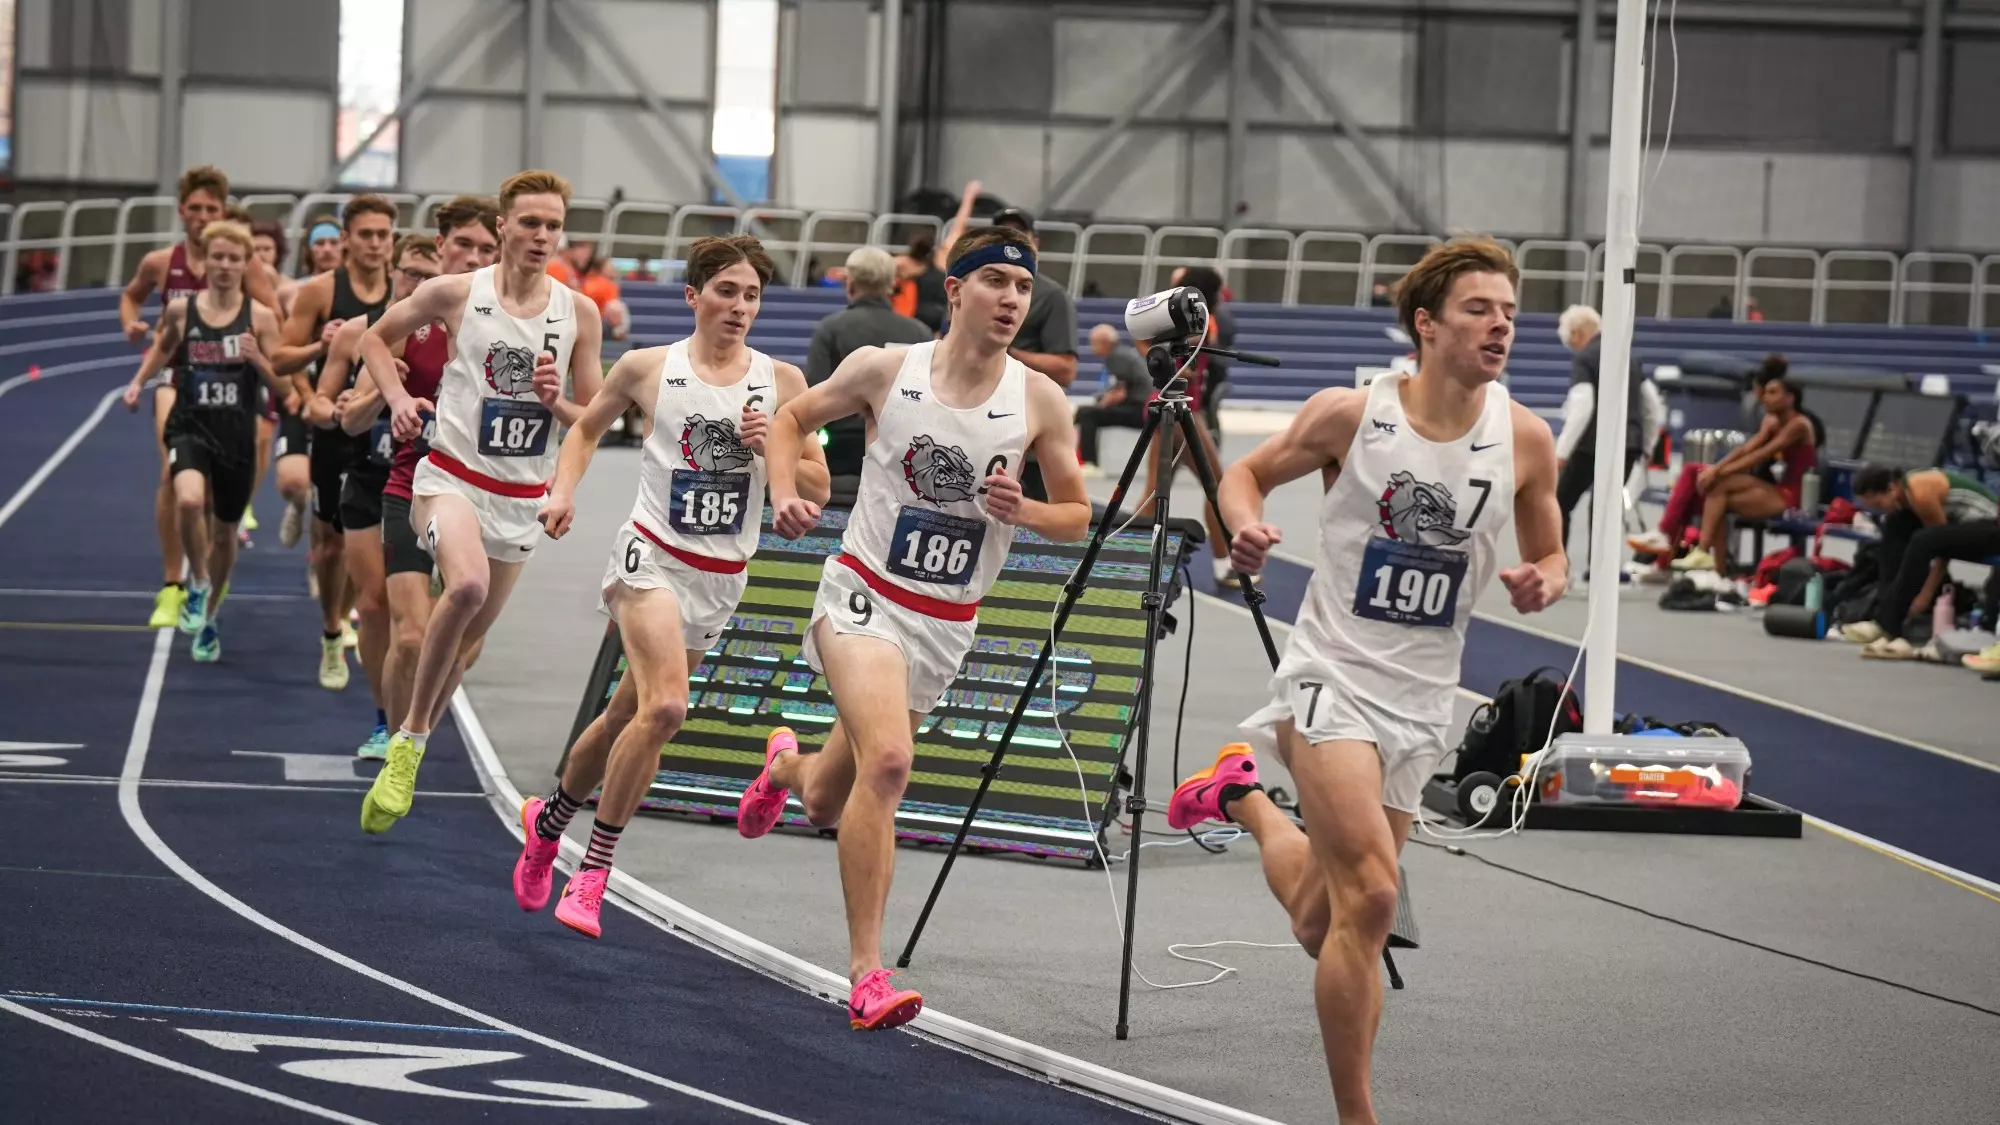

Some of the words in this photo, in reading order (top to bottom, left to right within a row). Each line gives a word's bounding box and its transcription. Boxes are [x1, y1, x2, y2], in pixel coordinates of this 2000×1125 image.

[475, 306, 492, 315] WCC
[199, 382, 238, 405] 138
[666, 378, 687, 387] WCC
[900, 388, 923, 401] WCC
[489, 416, 544, 449] 187
[1372, 419, 1397, 434] WCC
[681, 490, 739, 526] 185
[1466, 479, 1492, 528] 7
[625, 537, 645, 573] 6
[901, 530, 972, 575] 186
[1369, 565, 1450, 616] 190
[849, 591, 873, 625] 9
[1300, 682, 1323, 728] 7
